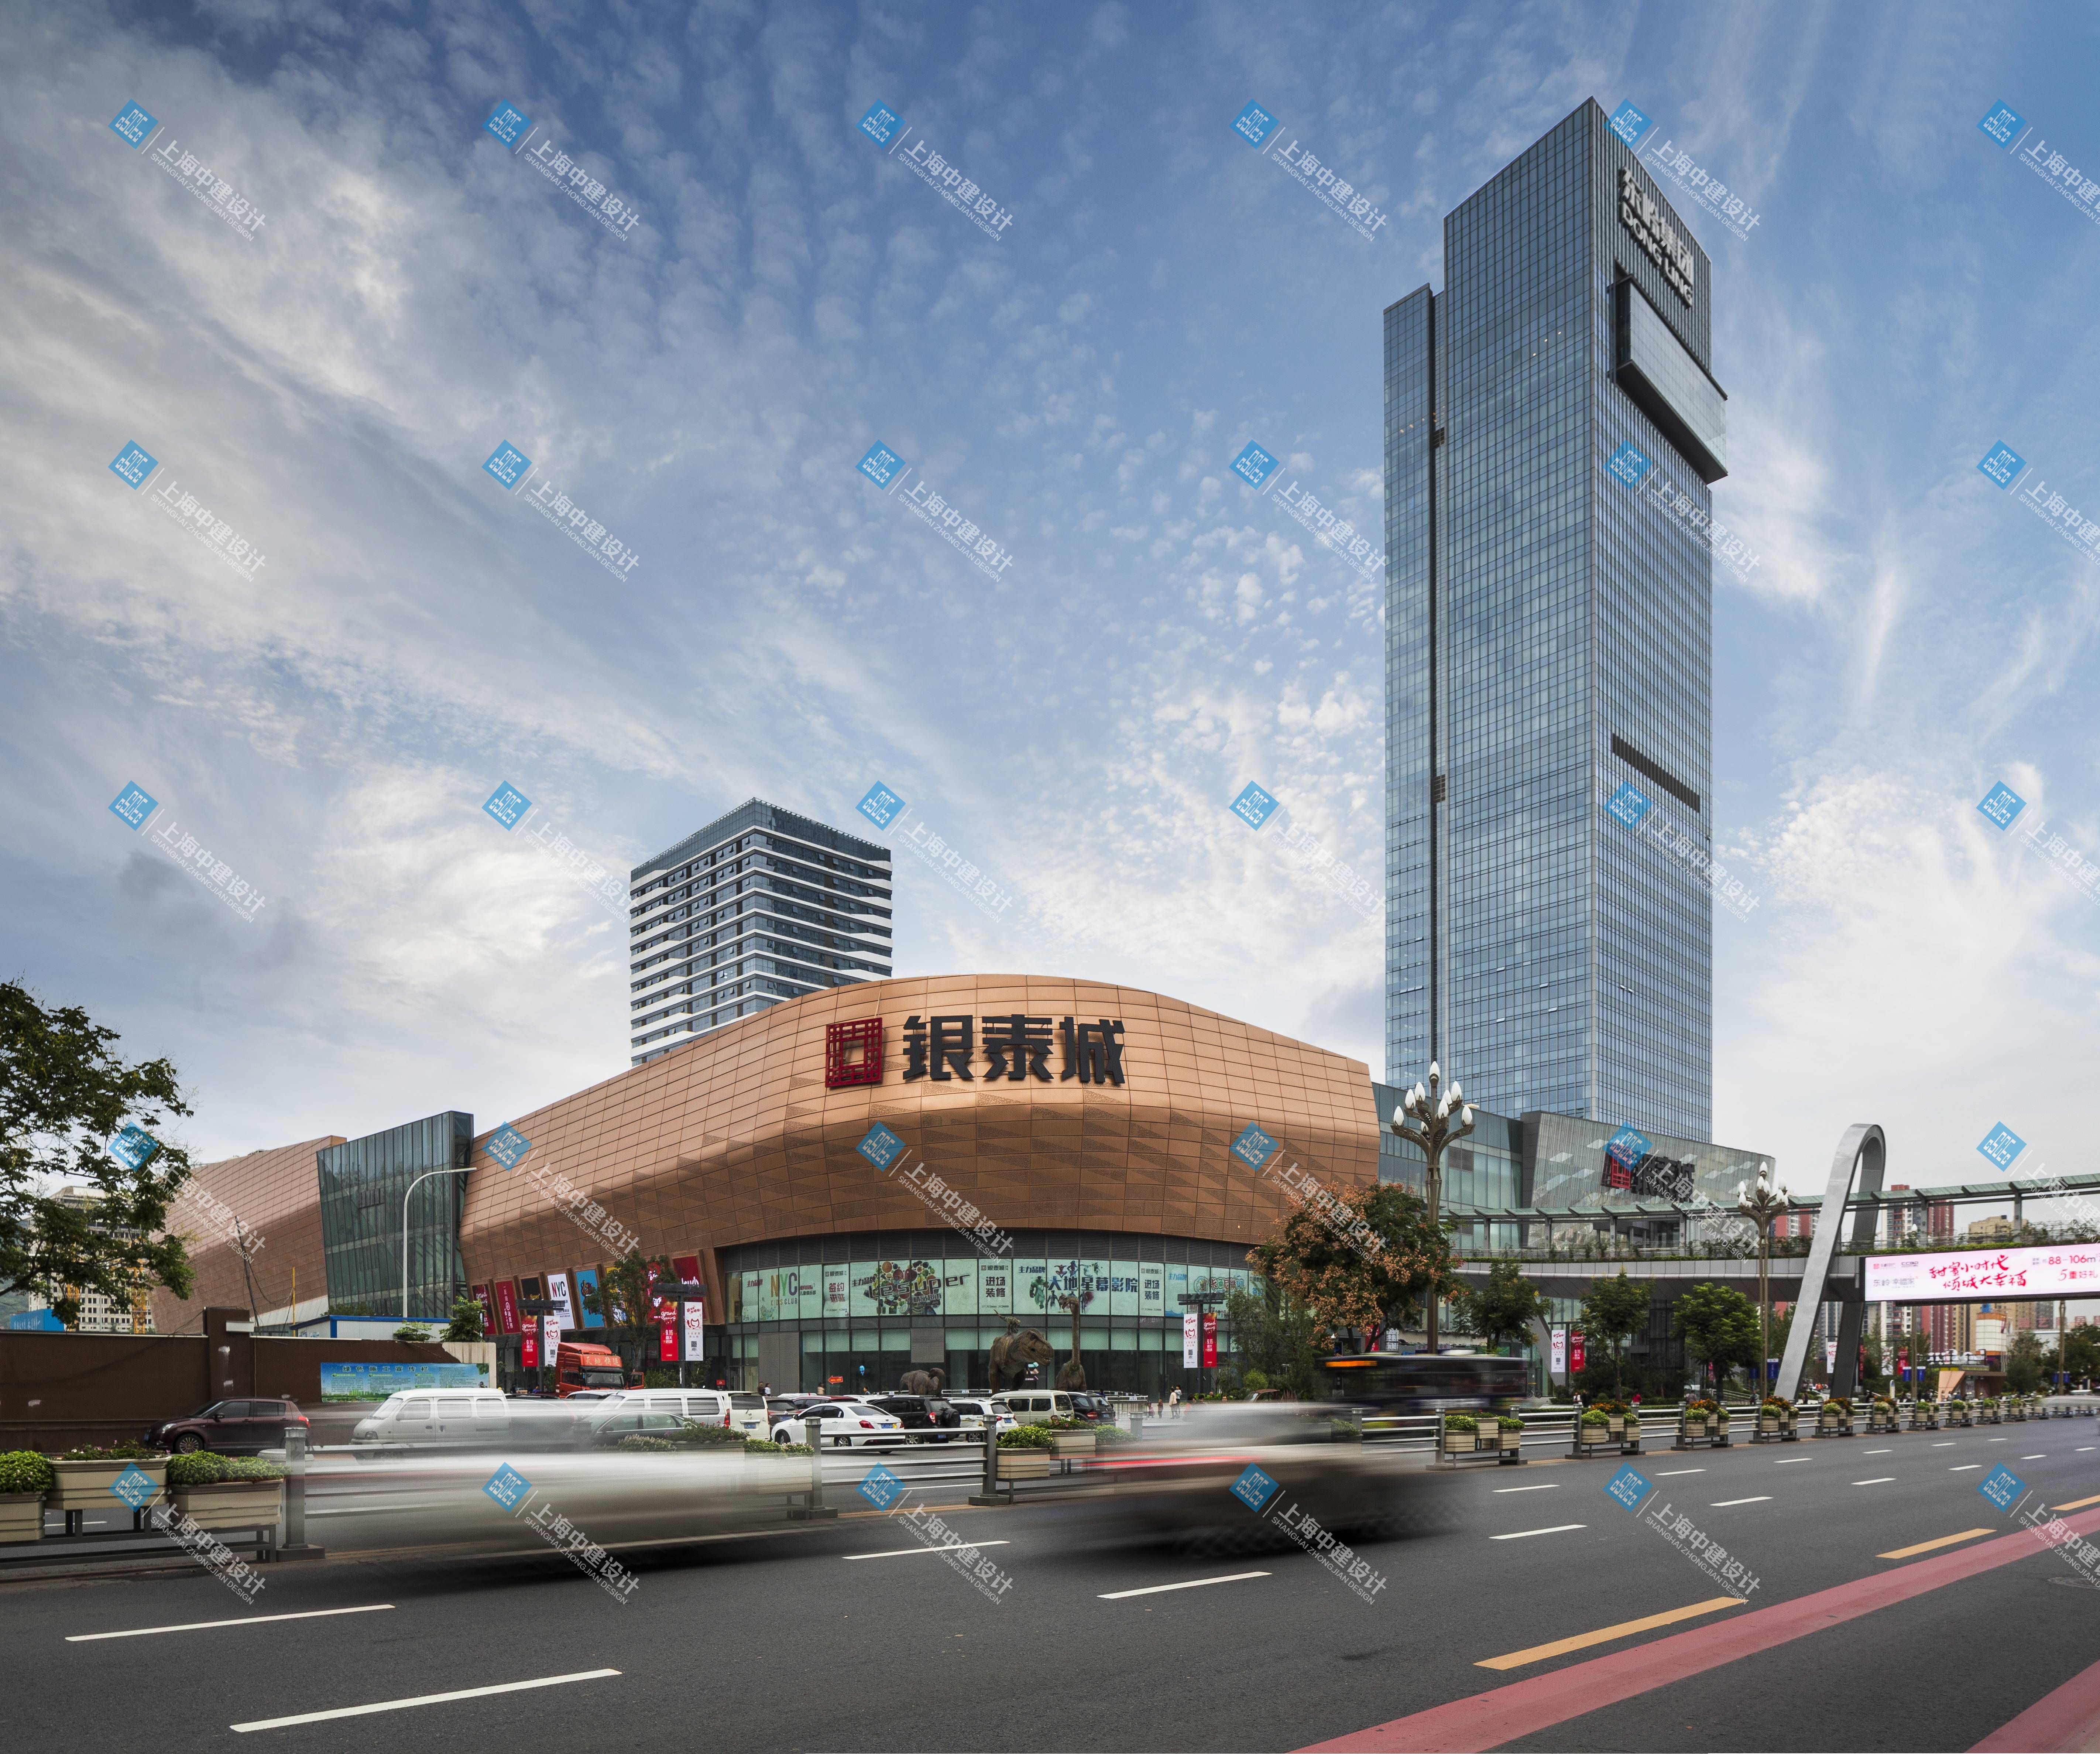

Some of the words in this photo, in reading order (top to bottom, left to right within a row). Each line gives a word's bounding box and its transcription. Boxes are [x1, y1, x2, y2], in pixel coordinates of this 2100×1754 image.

[1623, 202, 1662, 266] DONG
[1665, 258, 1693, 307] LING
[903, 1014, 1125, 1083] 银泰城
[771, 1272, 797, 1297] NYC
[852, 1277, 876, 1287] 主力品牌
[986, 1277, 1005, 1286] 进场
[1048, 1276, 1138, 1292] 大地星幕影院
[1145, 1279, 1159, 1289] 进场
[551, 1281, 566, 1297] NYC
[829, 1282, 844, 1292] 签约
[986, 1288, 1005, 1297] 装修
[1145, 1291, 1159, 1300] 装修
[661, 1307, 677, 1316] grand
[1204, 1318, 1216, 1326] grand
[586, 1356, 620, 1366] 天地快运
